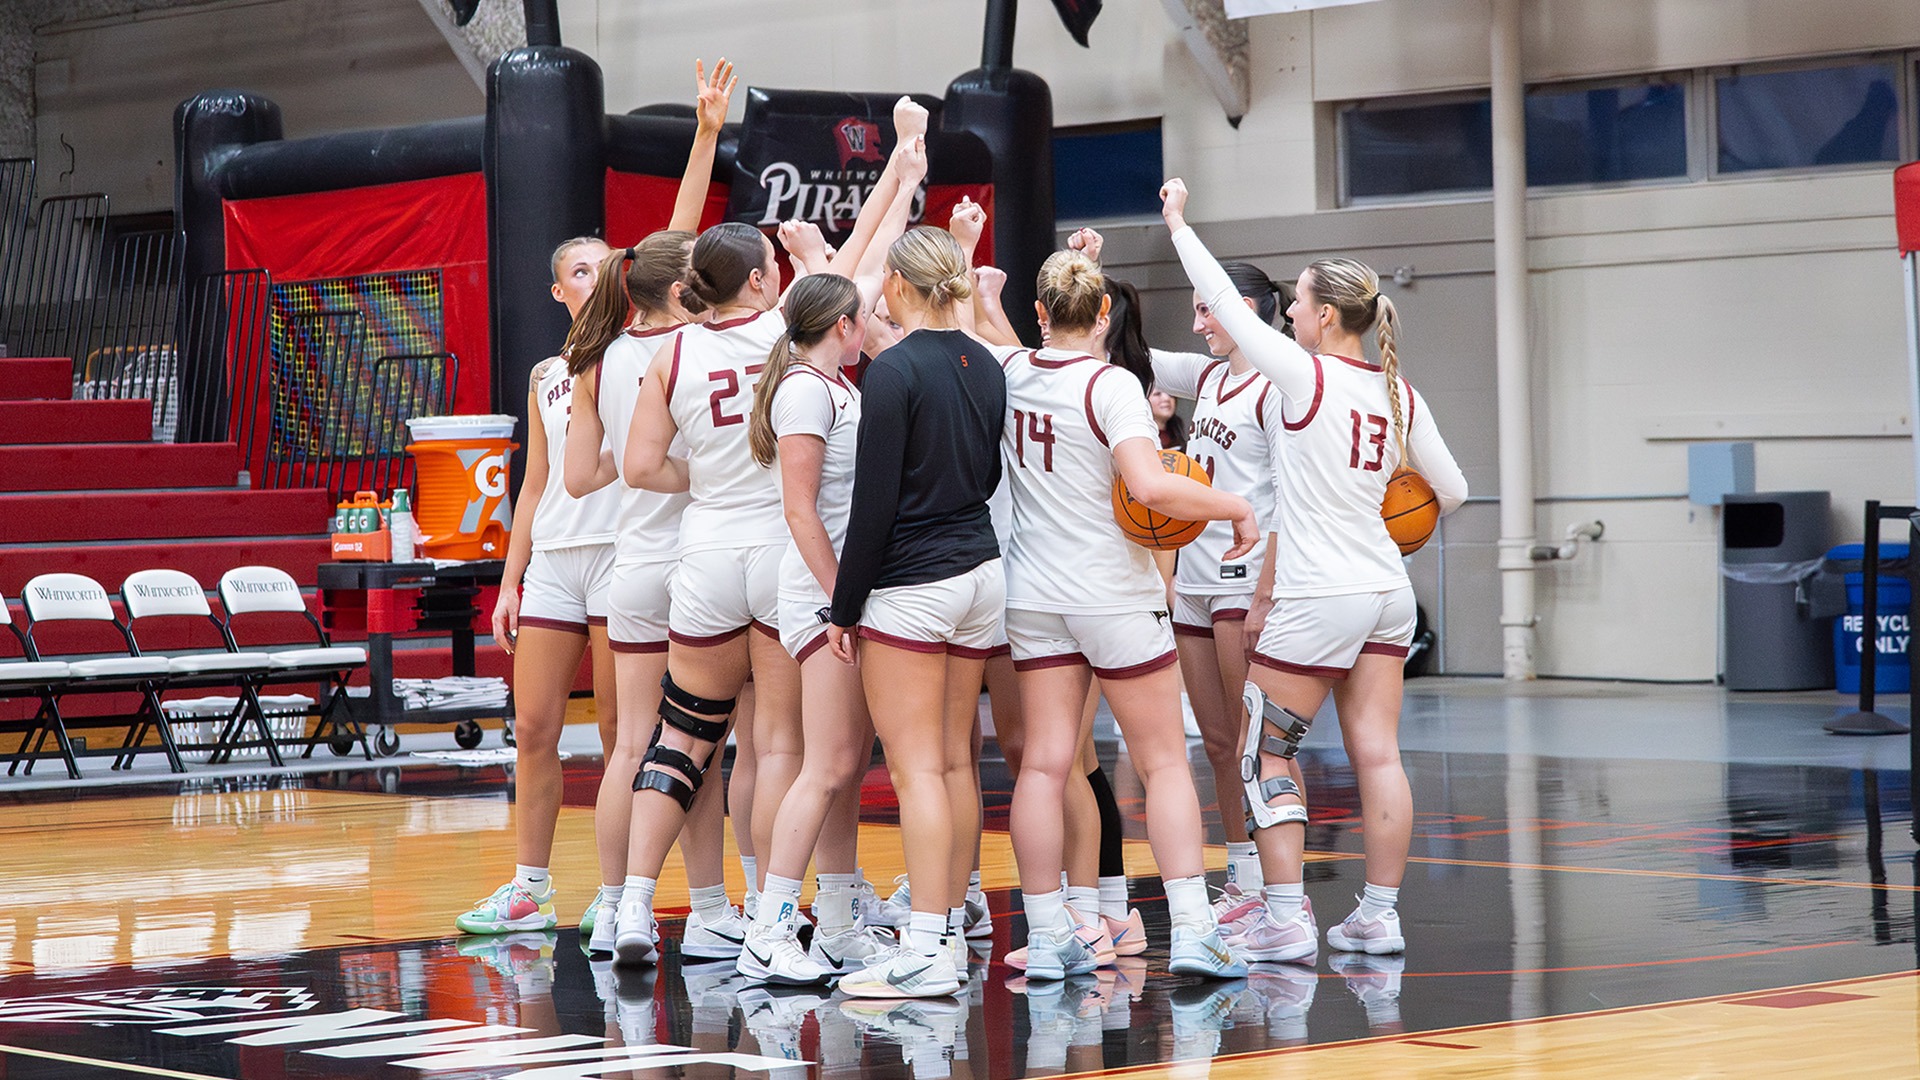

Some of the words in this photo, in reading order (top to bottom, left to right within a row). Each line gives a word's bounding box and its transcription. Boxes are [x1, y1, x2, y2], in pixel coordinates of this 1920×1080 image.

[1013, 409, 1056, 473] 14
[1349, 408, 1389, 472] 13
[474, 454, 506, 498] G
[1843, 614, 1911, 632] REYCL
